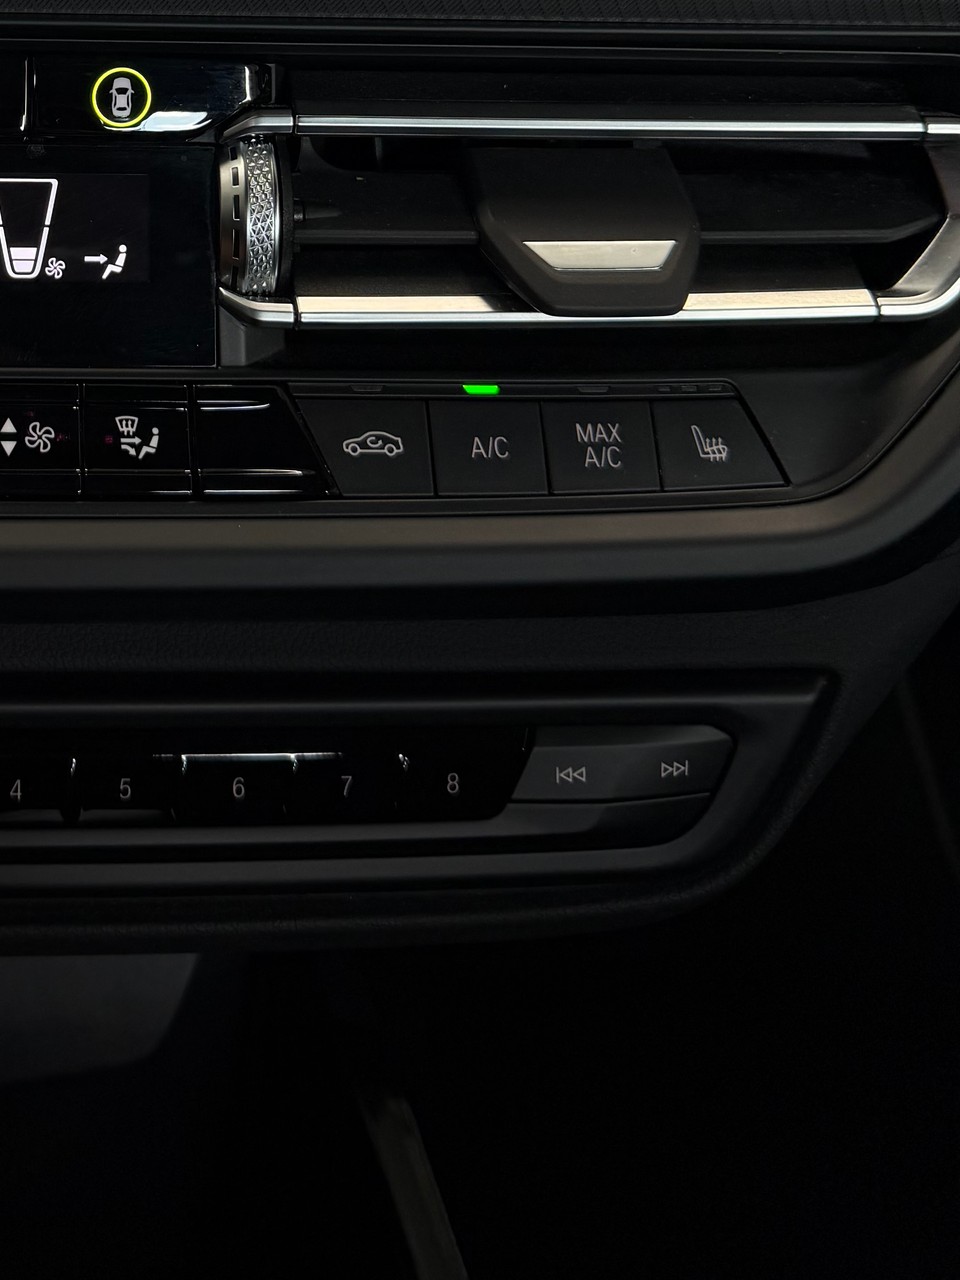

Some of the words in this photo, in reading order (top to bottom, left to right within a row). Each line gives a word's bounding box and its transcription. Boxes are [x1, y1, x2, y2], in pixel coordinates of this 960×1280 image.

[575, 423, 622, 443] MAX
[471, 436, 510, 459] A/C
[584, 446, 623, 468] A/C
[9, 779, 23, 801] 4
[119, 778, 132, 799] 5
[232, 776, 245, 798] 6
[341, 775, 353, 796] 7
[446, 772, 460, 794] 8
